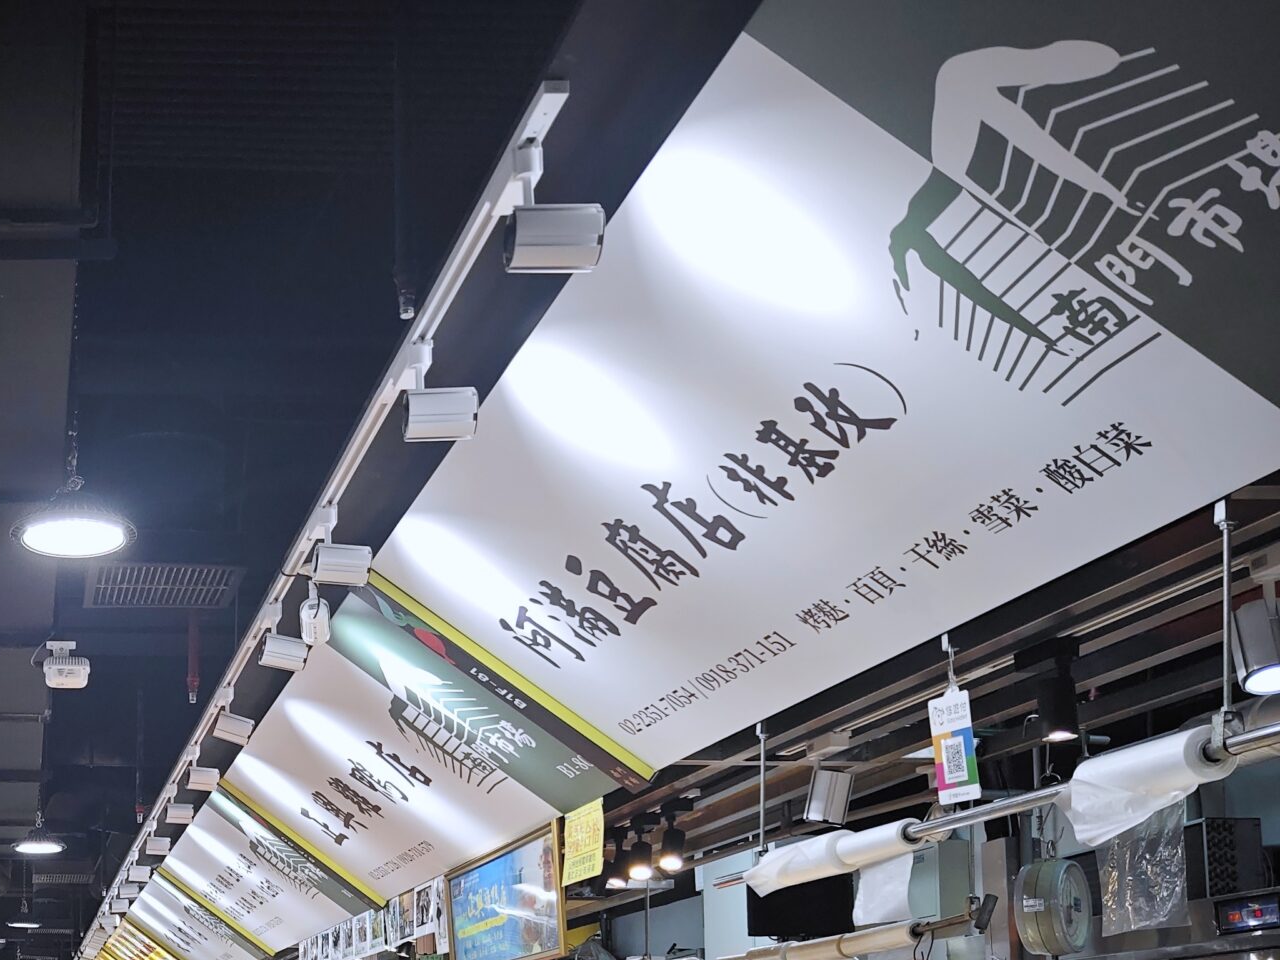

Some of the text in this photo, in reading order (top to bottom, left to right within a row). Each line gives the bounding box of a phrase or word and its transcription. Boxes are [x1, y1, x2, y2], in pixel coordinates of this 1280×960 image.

[470, 666, 528, 710] B1F-81
[617, 683, 699, 737] 02-2351-7054
[695, 630, 797, 692] 0918-371-151
